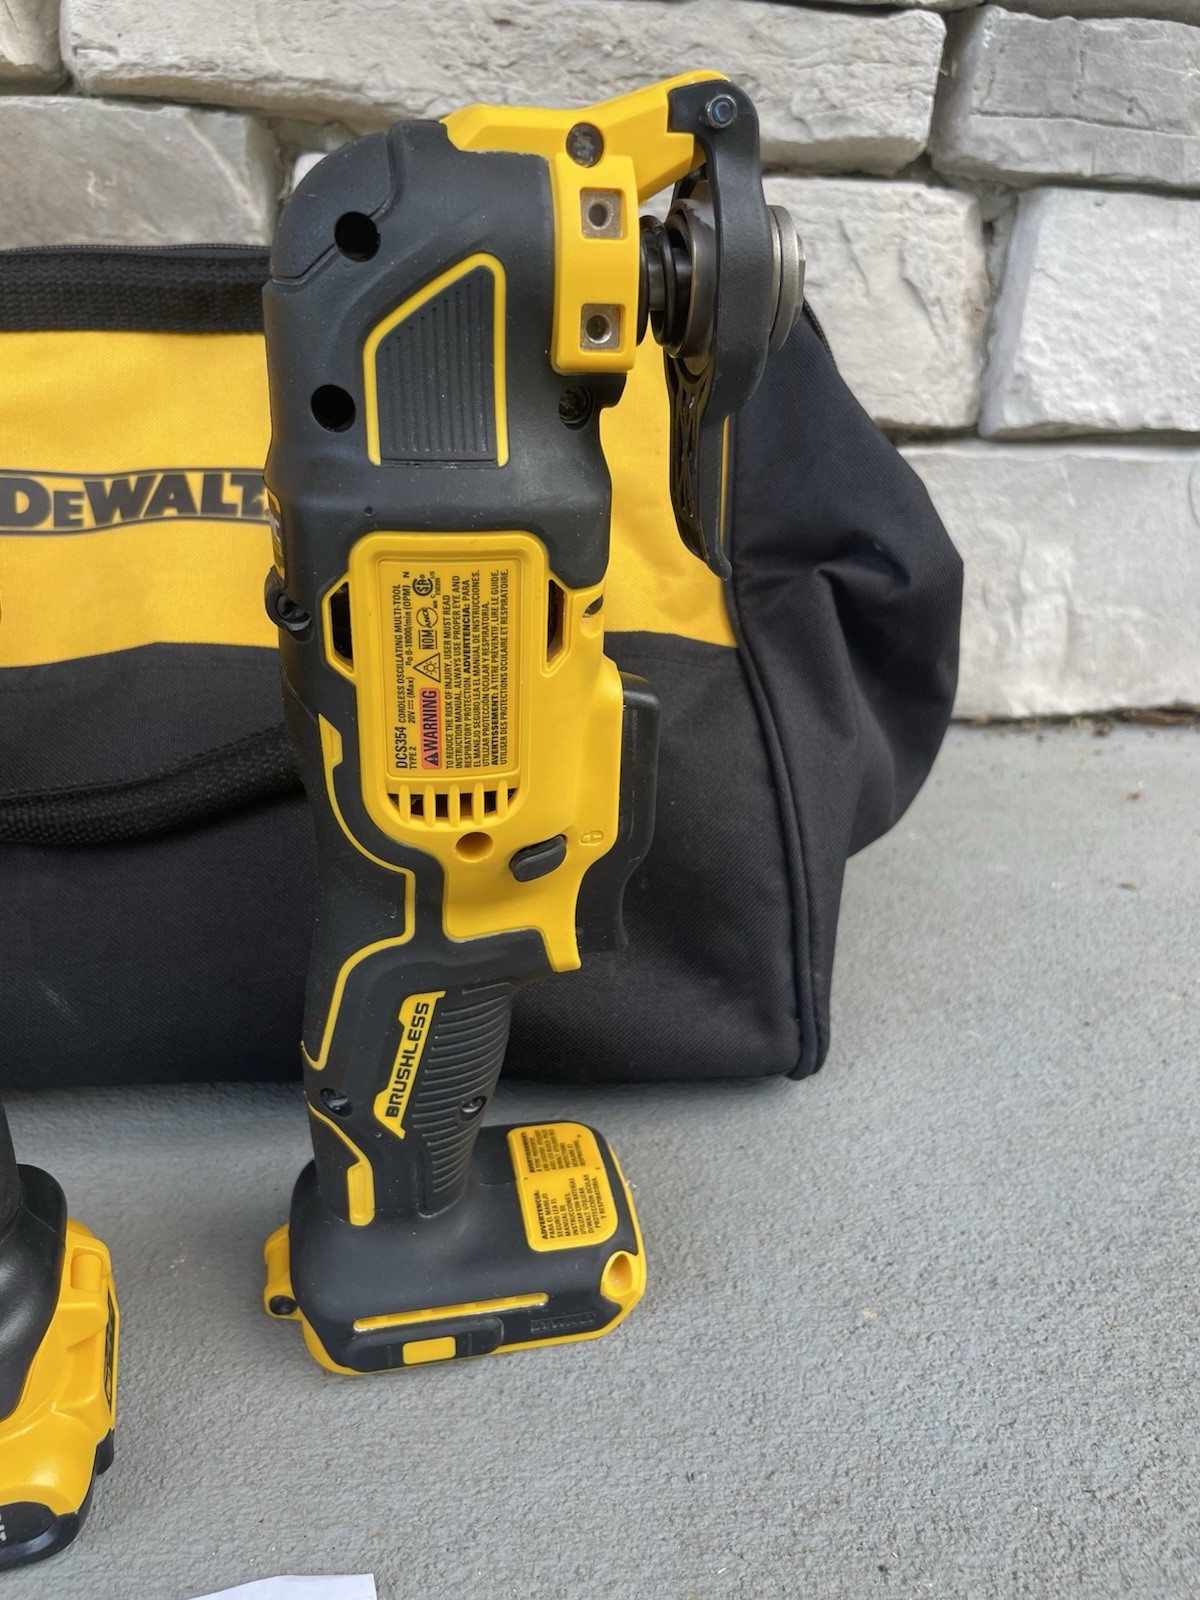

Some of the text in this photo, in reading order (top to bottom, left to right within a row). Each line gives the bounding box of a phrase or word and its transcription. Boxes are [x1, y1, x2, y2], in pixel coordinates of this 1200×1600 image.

[452, 576, 460, 593] AND
[462, 580, 470, 600] PARA
[491, 570, 499, 595] GUIDE.
[403, 585, 411, 610] (OPM)
[443, 595, 451, 615] READ
[472, 570, 480, 632] INSTRUCCIONES.
[491, 597, 499, 605] LE
[500, 569, 508, 624] RESPIRATOIRE.
[453, 611, 461, 639] PROPER
[491, 607, 499, 622] LIRE
[443, 617, 451, 638] MUST
[472, 634, 480, 643] DE
[500, 626, 508, 634] ET
[421, 630, 434, 649] NOM
[472, 645, 480, 676] MANUAL
[500, 637, 508, 671] OCULAIRE
[392, 584, 407, 768] DCS354 CORDLESS OSCILLATING MULTI-TOOL
[444, 661, 453, 689] INJURY,
[473, 677, 480, 685] EL
[482, 665, 490, 691] OCULAR
[445, 691, 452, 699] OF
[407, 711, 415, 723] 20V
[445, 702, 453, 717] RISK
[421, 691, 438, 752] WARNING
[491, 693, 499, 765] AVERTISSEMENT:
[464, 723, 472, 768] RESPIRATORY
[482, 738, 490, 766] UTILIZAR
[409, 755, 417, 769] TYPE
[446, 761, 453, 769] TO
[385, 1002, 430, 1118] BRUSHLESS
